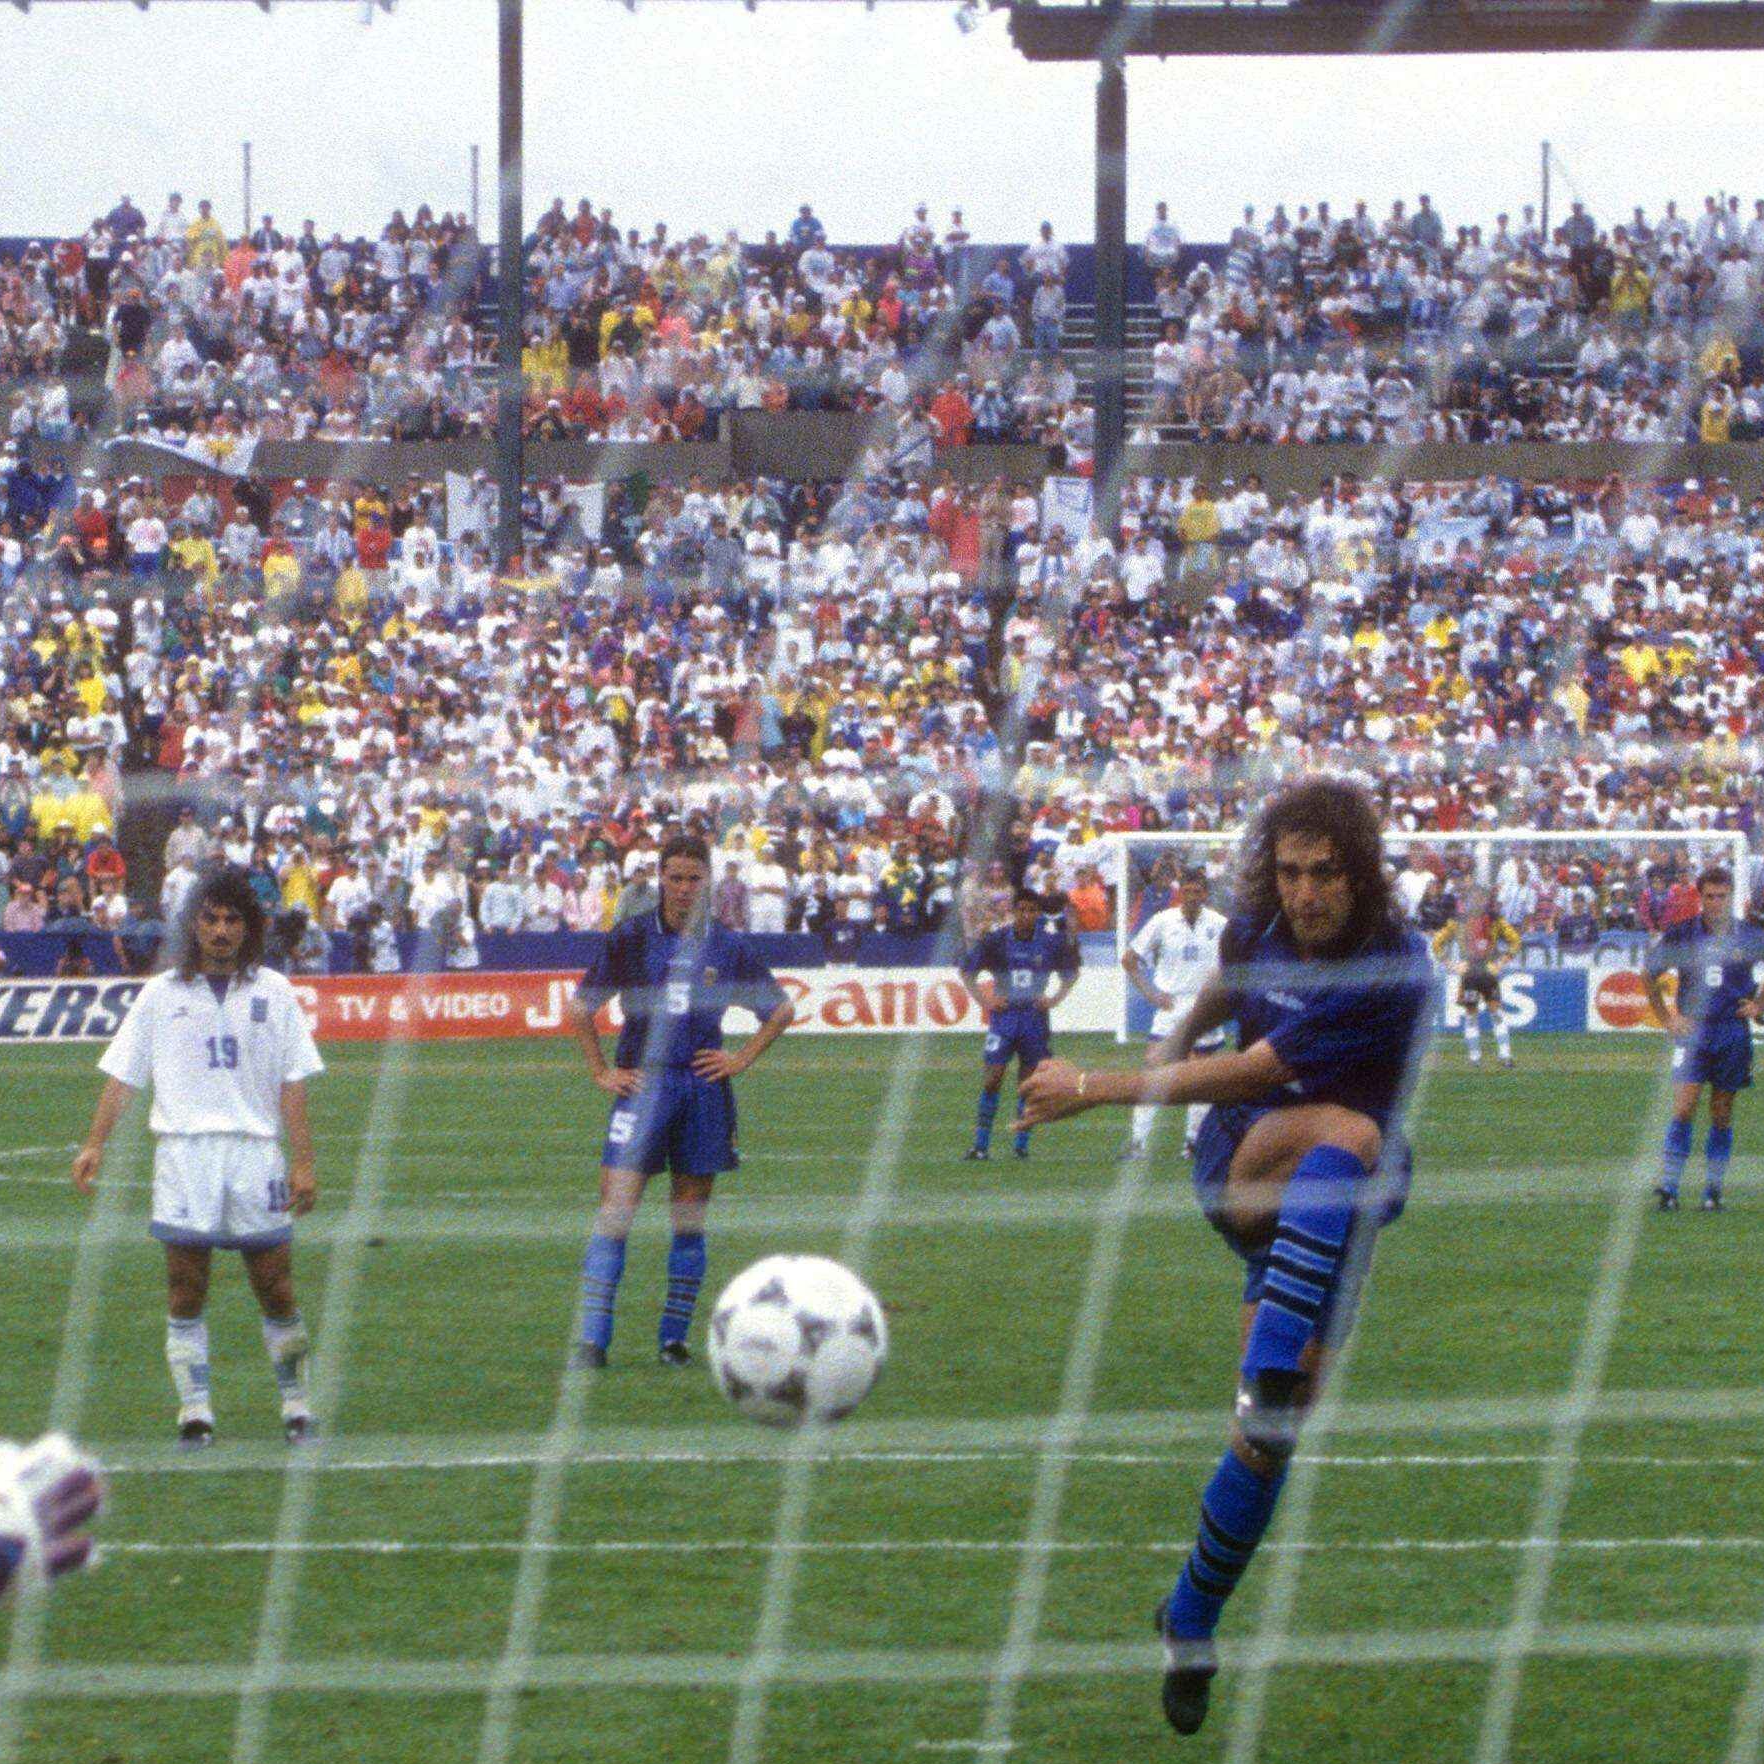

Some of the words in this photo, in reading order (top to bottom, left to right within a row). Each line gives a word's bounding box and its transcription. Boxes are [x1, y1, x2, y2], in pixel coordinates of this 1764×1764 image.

[337, 995, 376, 1021] TV
[421, 992, 510, 1019] VIDEO
[668, 982, 691, 1015] 5
[207, 1036, 238, 1070] 19
